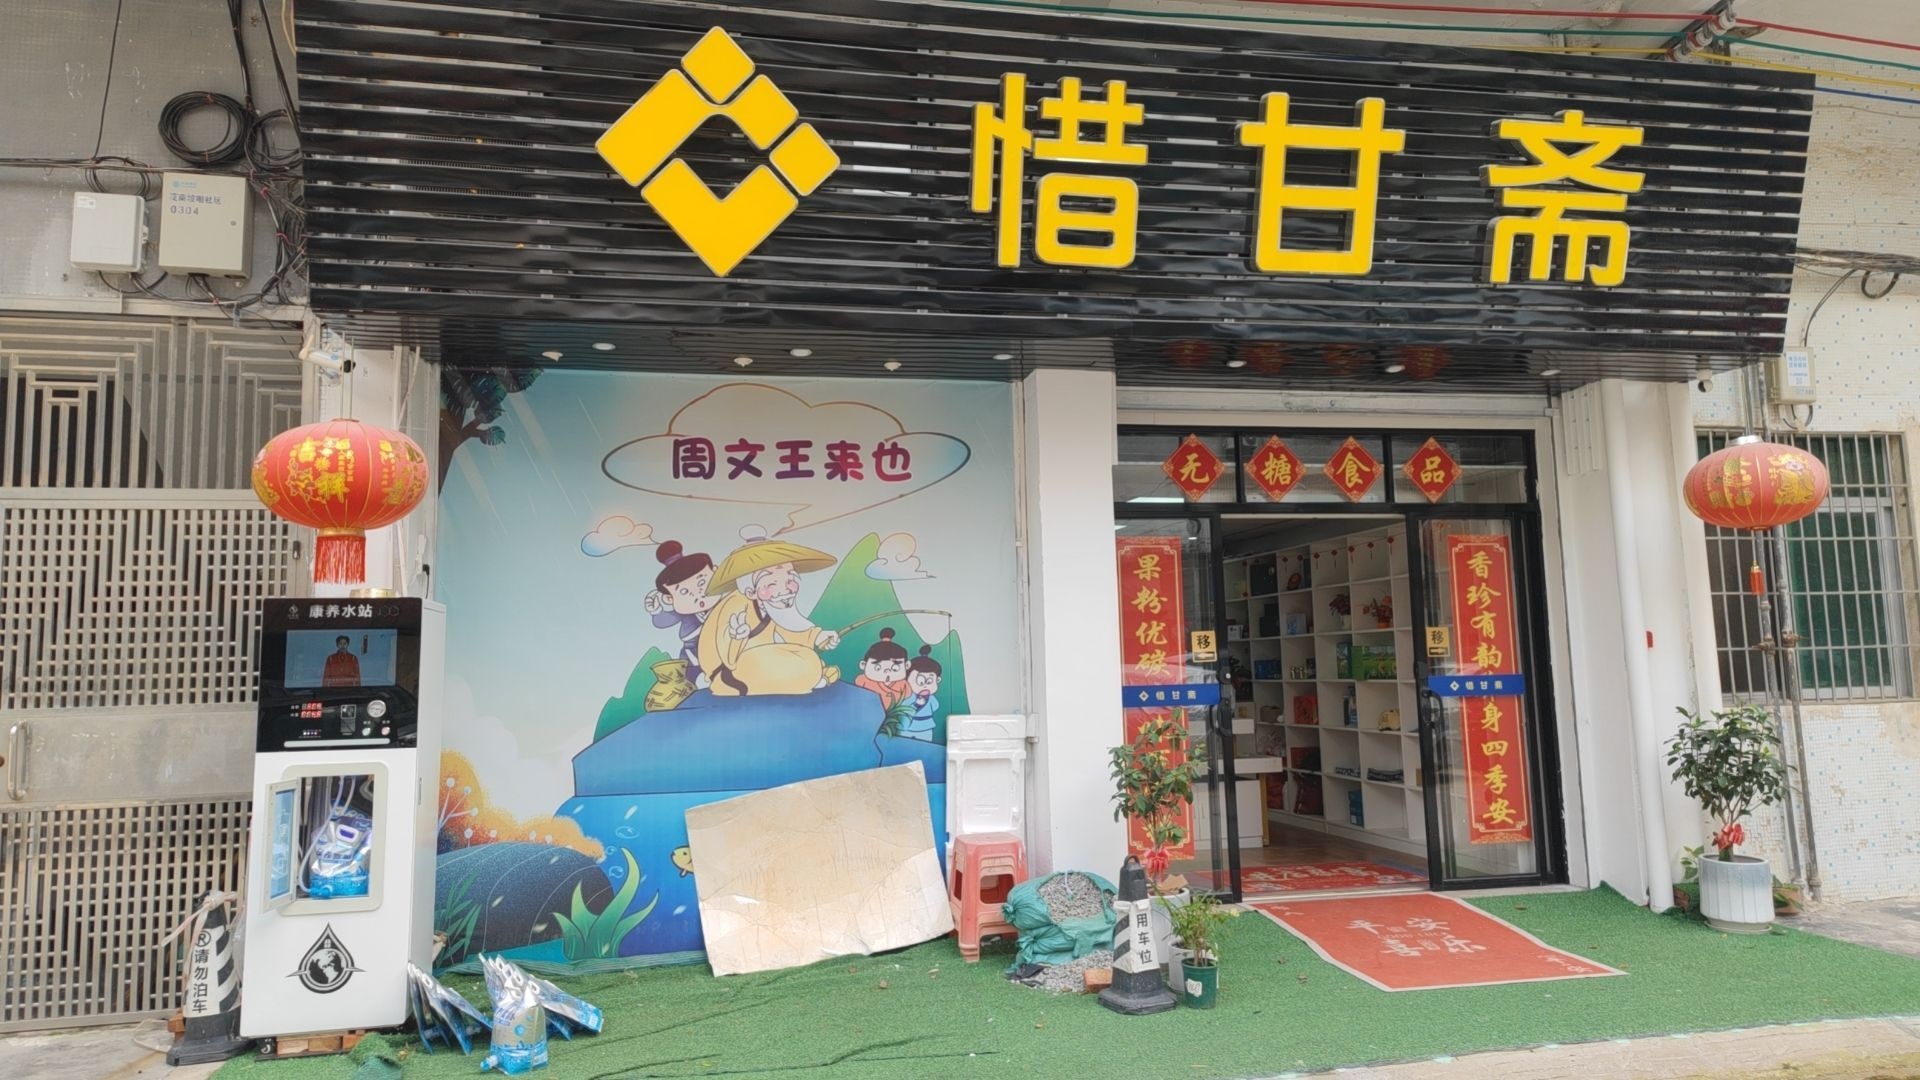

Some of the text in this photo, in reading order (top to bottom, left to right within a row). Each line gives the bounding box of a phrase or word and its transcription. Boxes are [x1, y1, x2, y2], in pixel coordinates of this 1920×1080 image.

[971, 73, 1646, 287] 惜甘斋
[672, 437, 912, 482] 周文王来也
[309, 604, 373, 619] 康养水站
[1197, 634, 1211, 650] 移
[1430, 630, 1444, 645] 移
[1136, 912, 1153, 965] 用车位
[191, 949, 210, 1014] 请勿泊车
